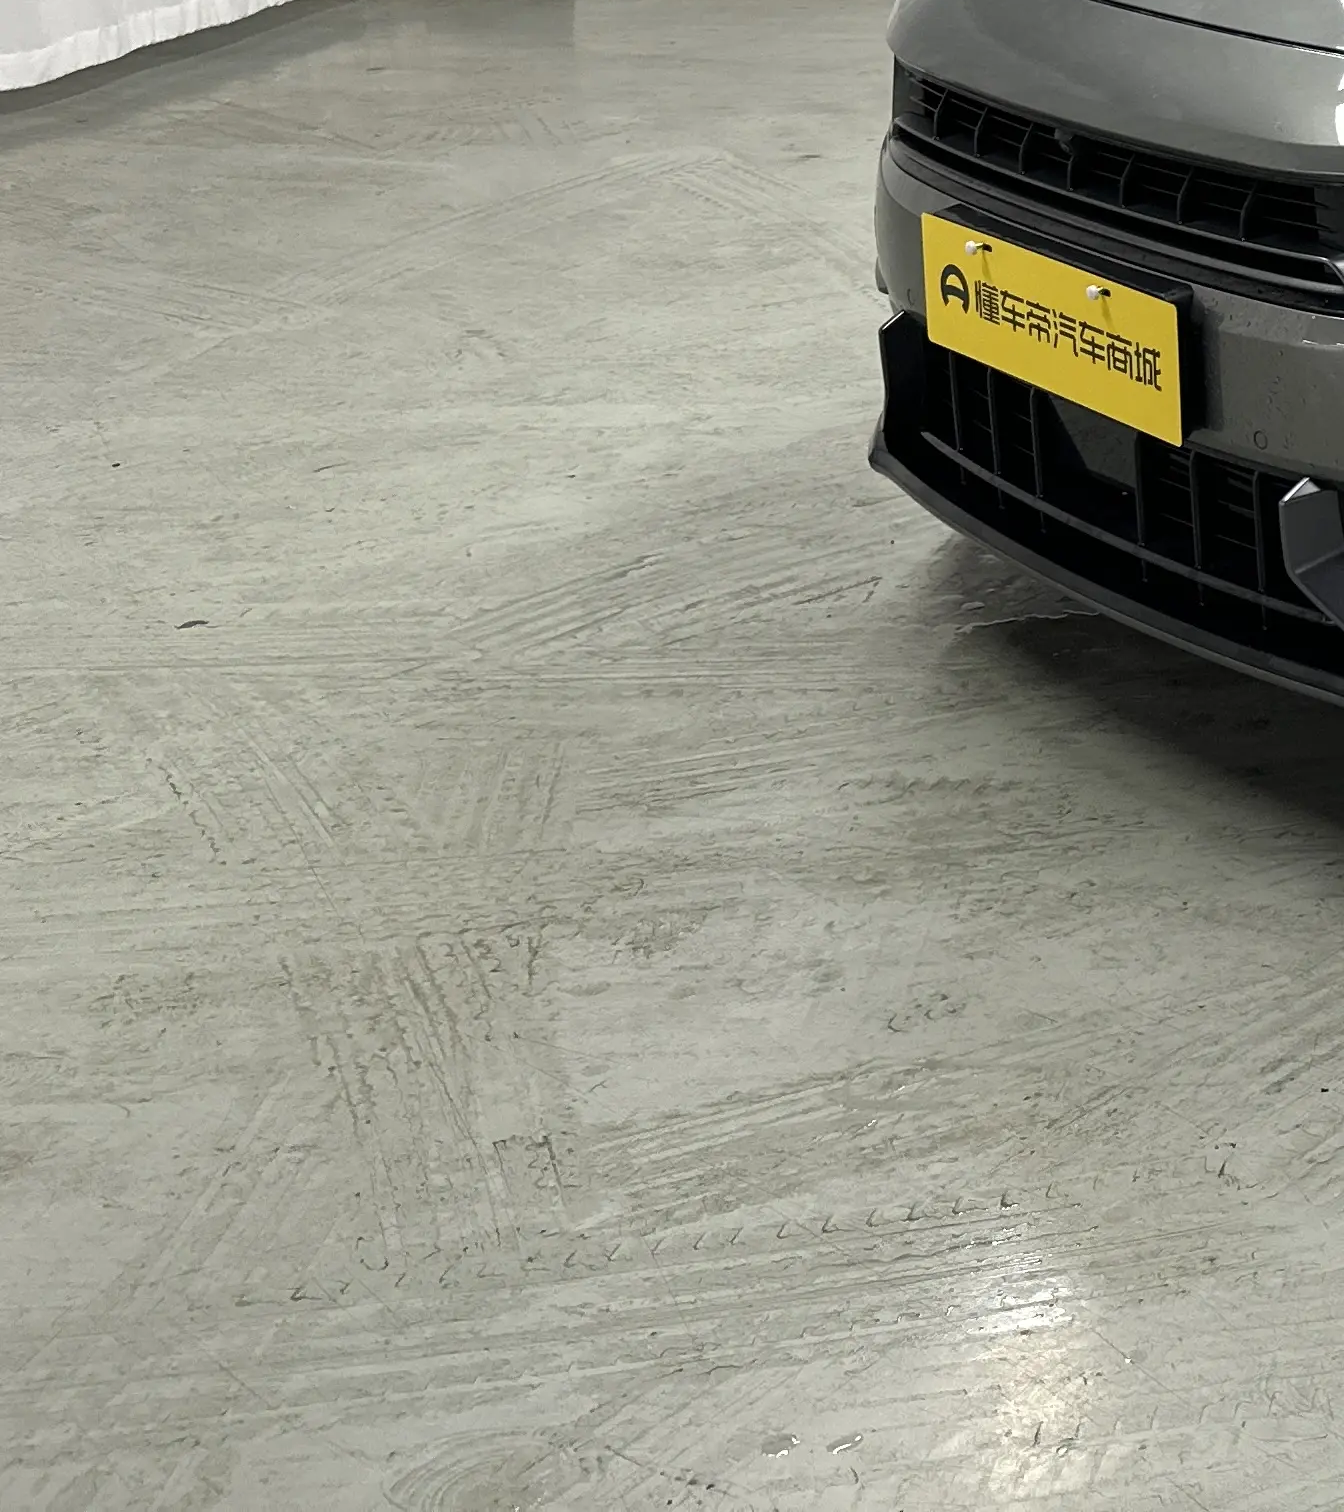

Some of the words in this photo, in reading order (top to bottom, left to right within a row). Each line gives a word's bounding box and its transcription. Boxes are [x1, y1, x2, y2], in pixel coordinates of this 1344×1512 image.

[974, 280, 1163, 392] 懂车帝汽车商城
